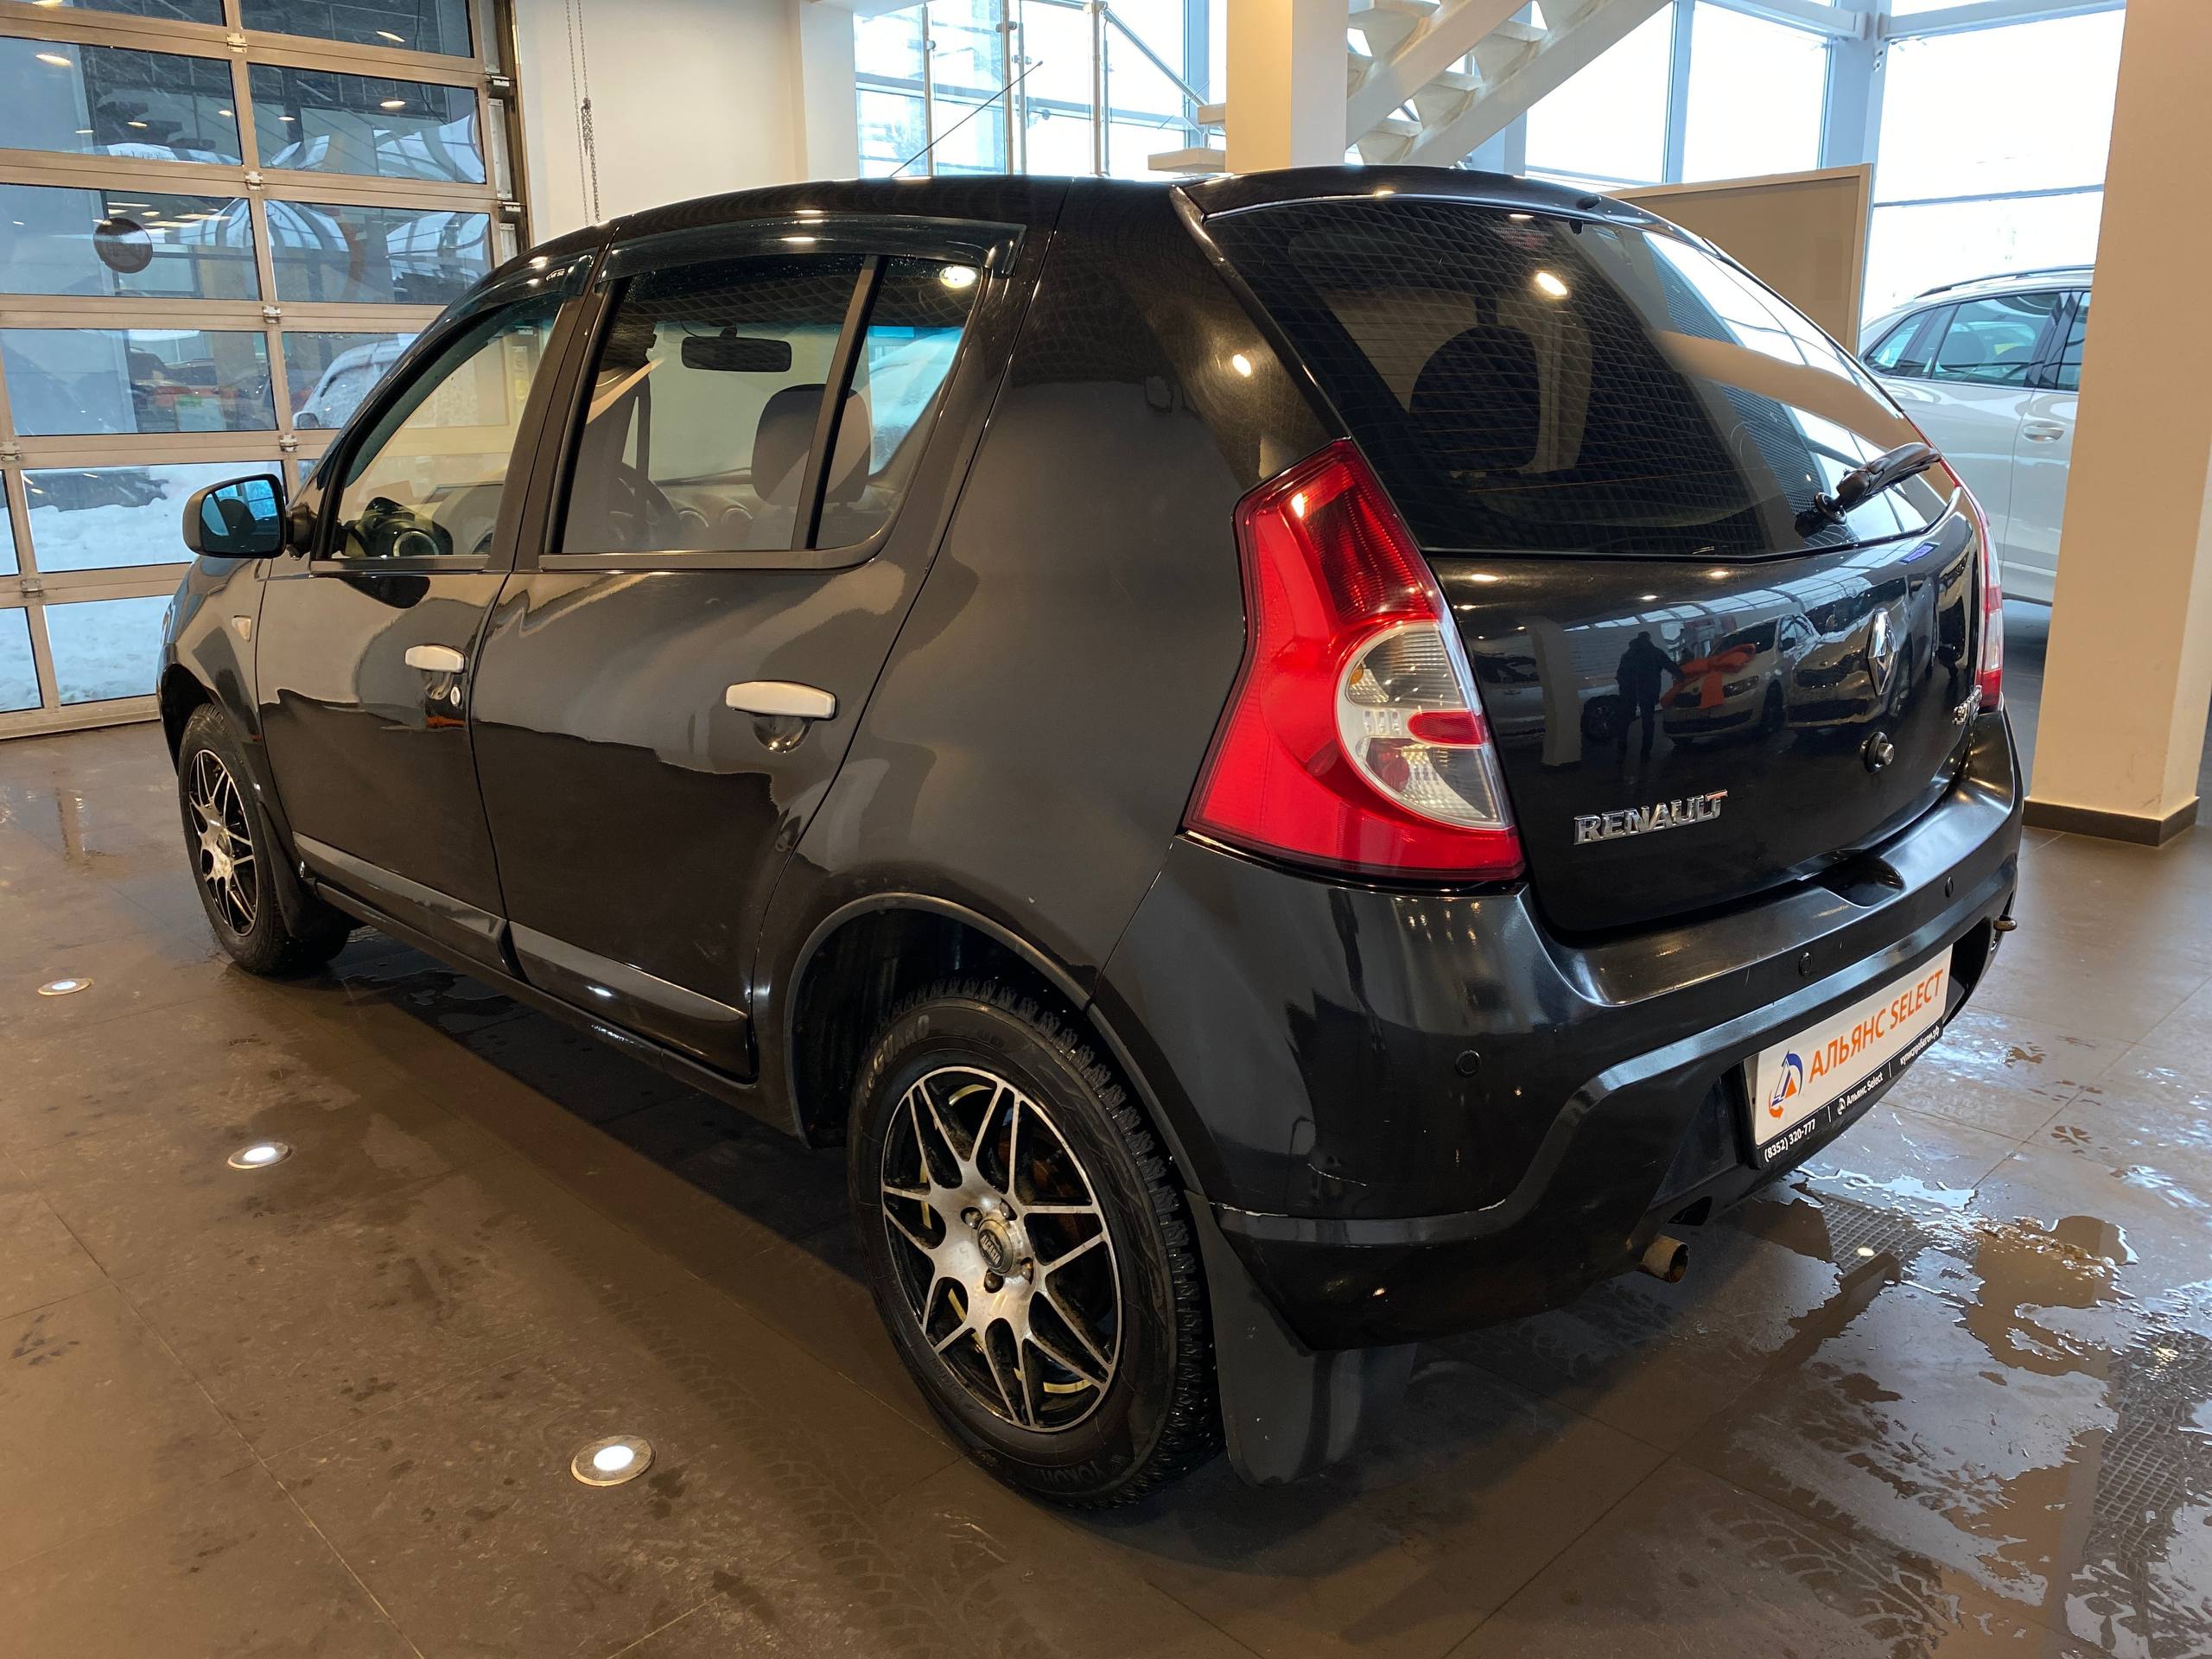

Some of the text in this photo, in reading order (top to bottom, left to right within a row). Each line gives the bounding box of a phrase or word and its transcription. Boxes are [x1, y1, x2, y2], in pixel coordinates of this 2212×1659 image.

[1573, 790, 1728, 845] RENAULT
[1808, 969, 1944, 1084] АЛЬЯНС SELECT
[1764, 1138, 1789, 1162] (8352)
[1789, 1118, 1816, 1146] 320-777
[1847, 1085, 1868, 1107] Альянс
[1867, 1071, 1884, 1091] Select
